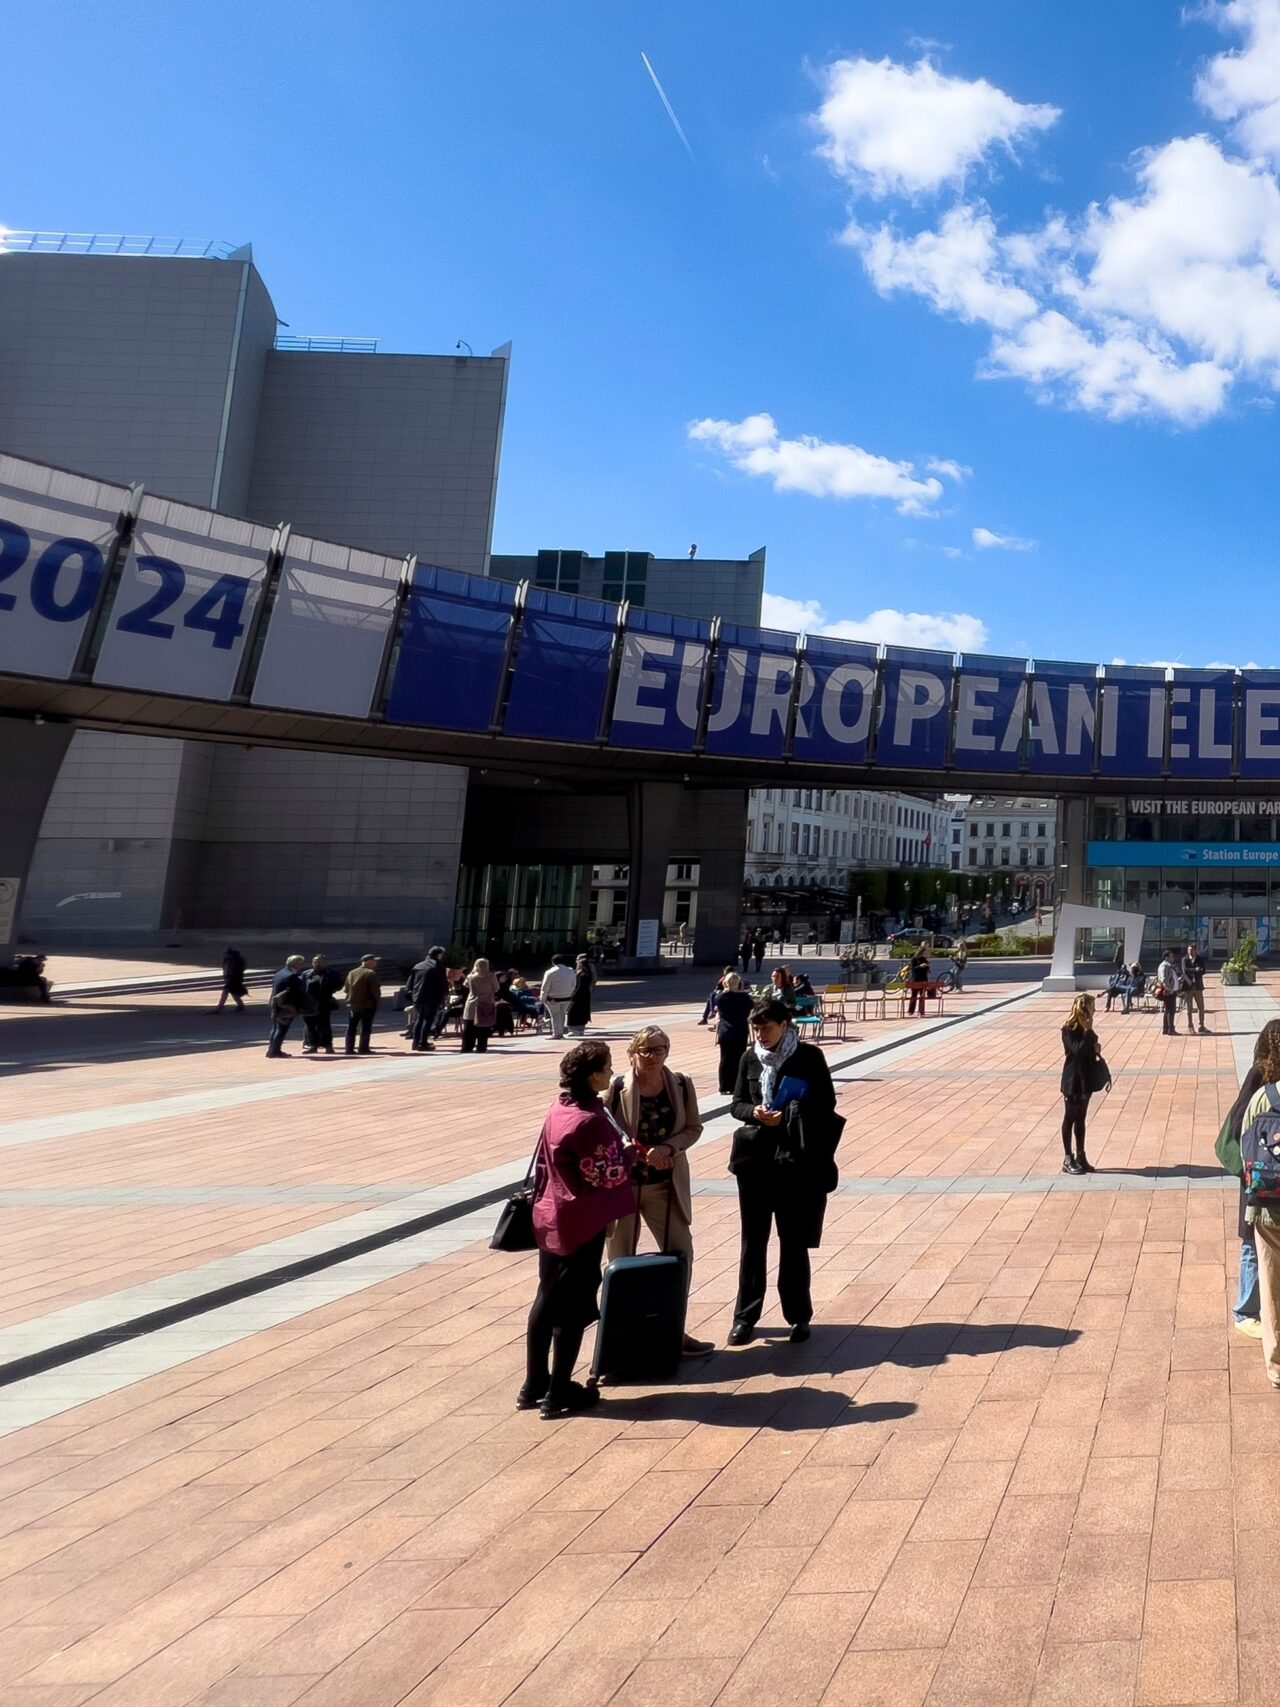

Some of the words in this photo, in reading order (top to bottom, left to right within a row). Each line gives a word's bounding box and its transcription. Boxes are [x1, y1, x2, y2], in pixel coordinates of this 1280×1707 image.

[612, 631, 1119, 757] EUROPEAN
[1131, 800, 1163, 814] VISIT
[1165, 800, 1189, 814] THE
[1191, 800, 1256, 815] EUROPEAN
[1202, 848, 1241, 860] Station
[1242, 849, 1279, 862] Europe
